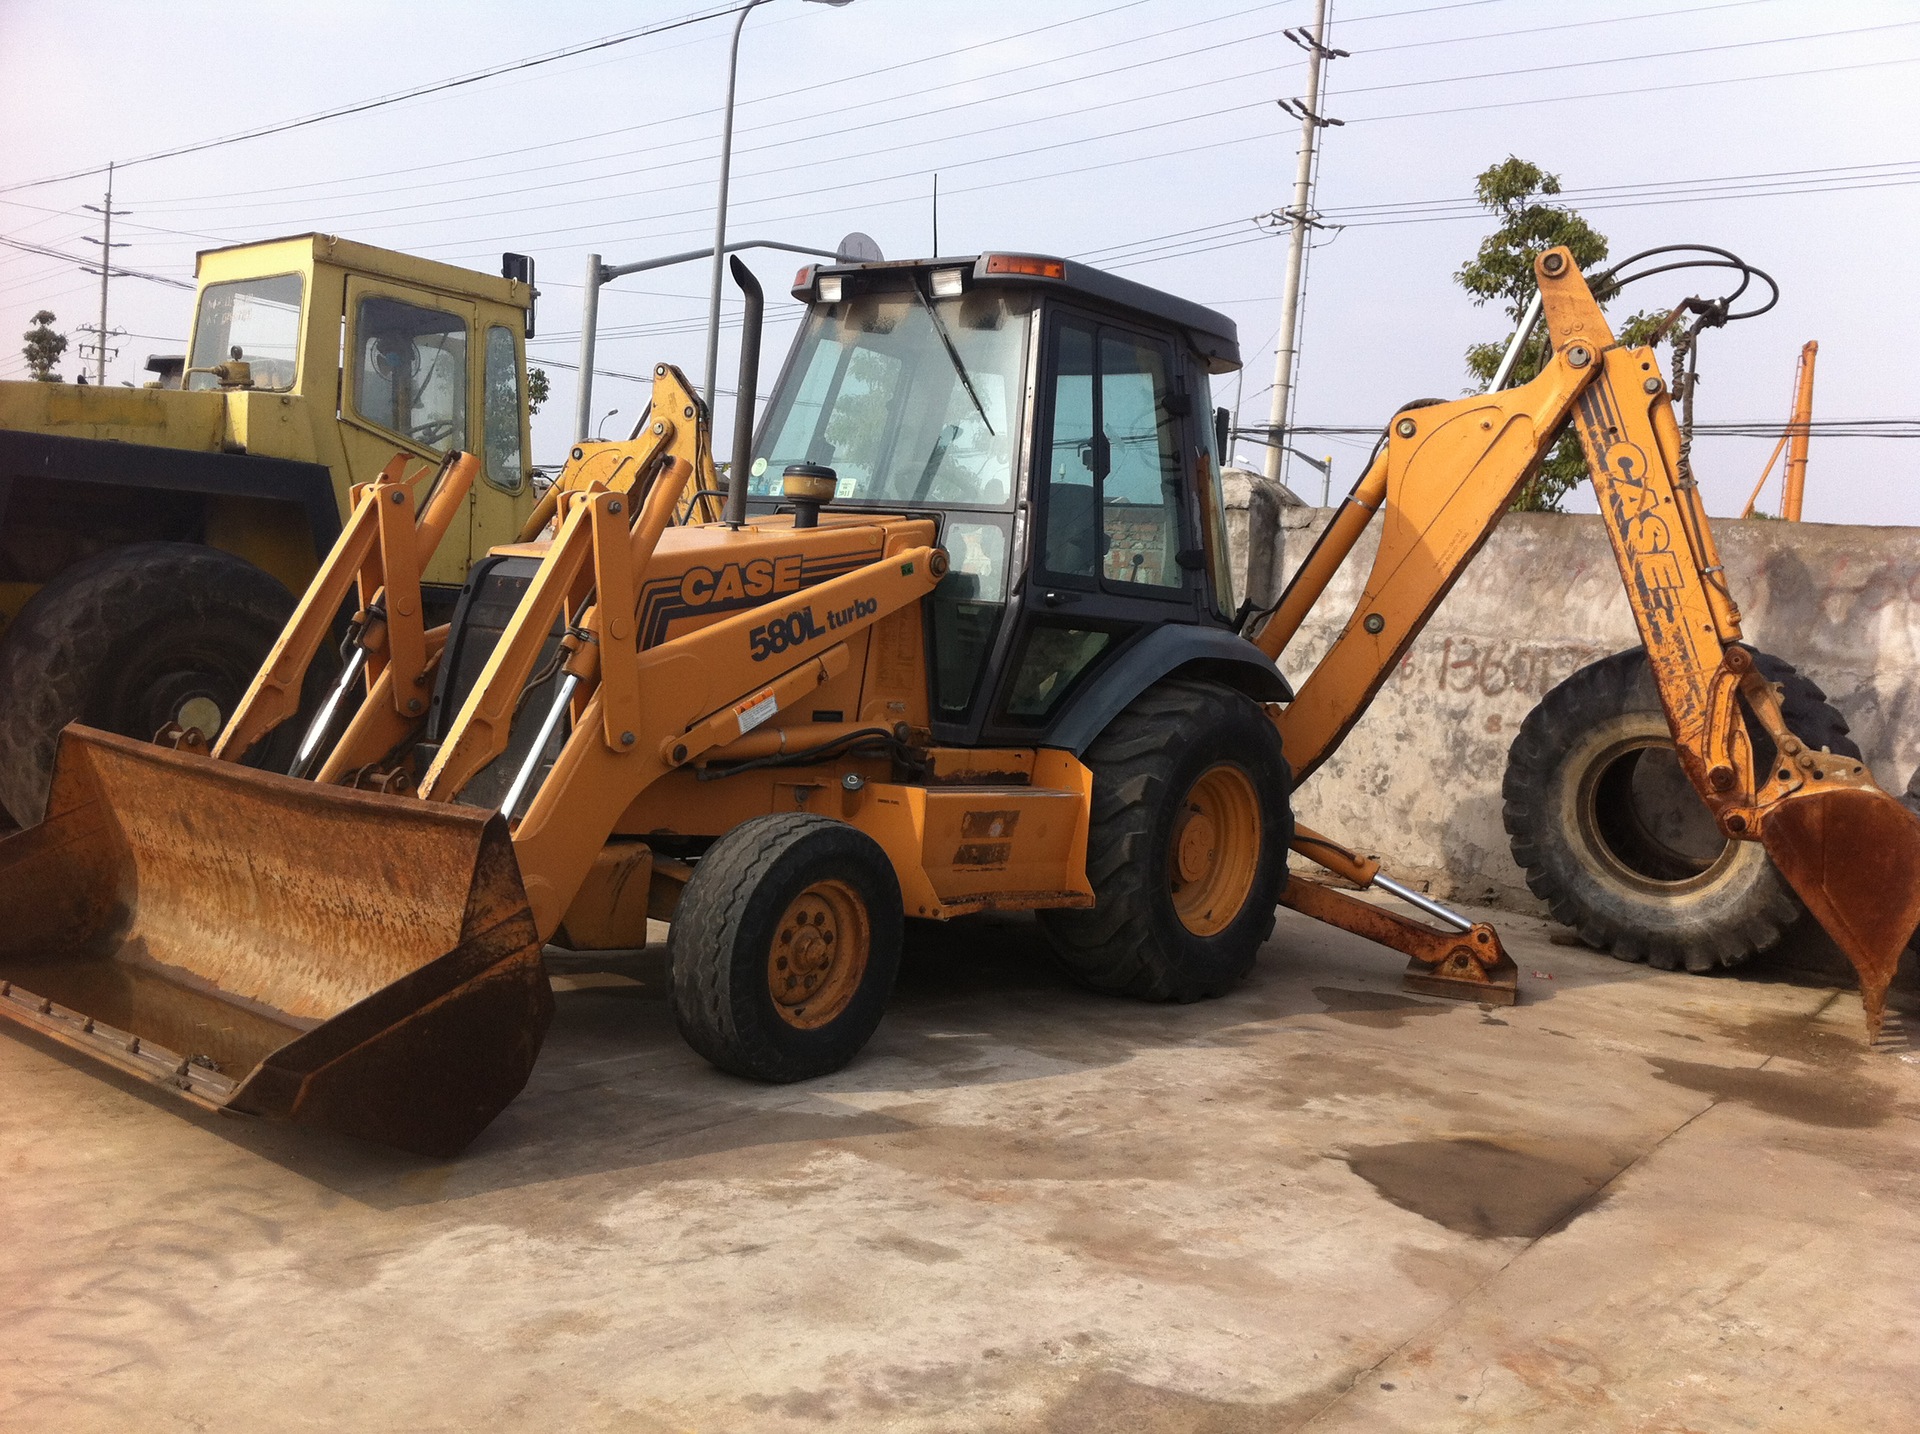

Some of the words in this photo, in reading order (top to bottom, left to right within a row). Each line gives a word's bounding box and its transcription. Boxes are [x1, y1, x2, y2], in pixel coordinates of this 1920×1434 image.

[1605, 441, 1685, 589] CASE
[680, 554, 804, 606] CASE
[749, 606, 826, 662] 580L
[827, 597, 877, 630] turbo
